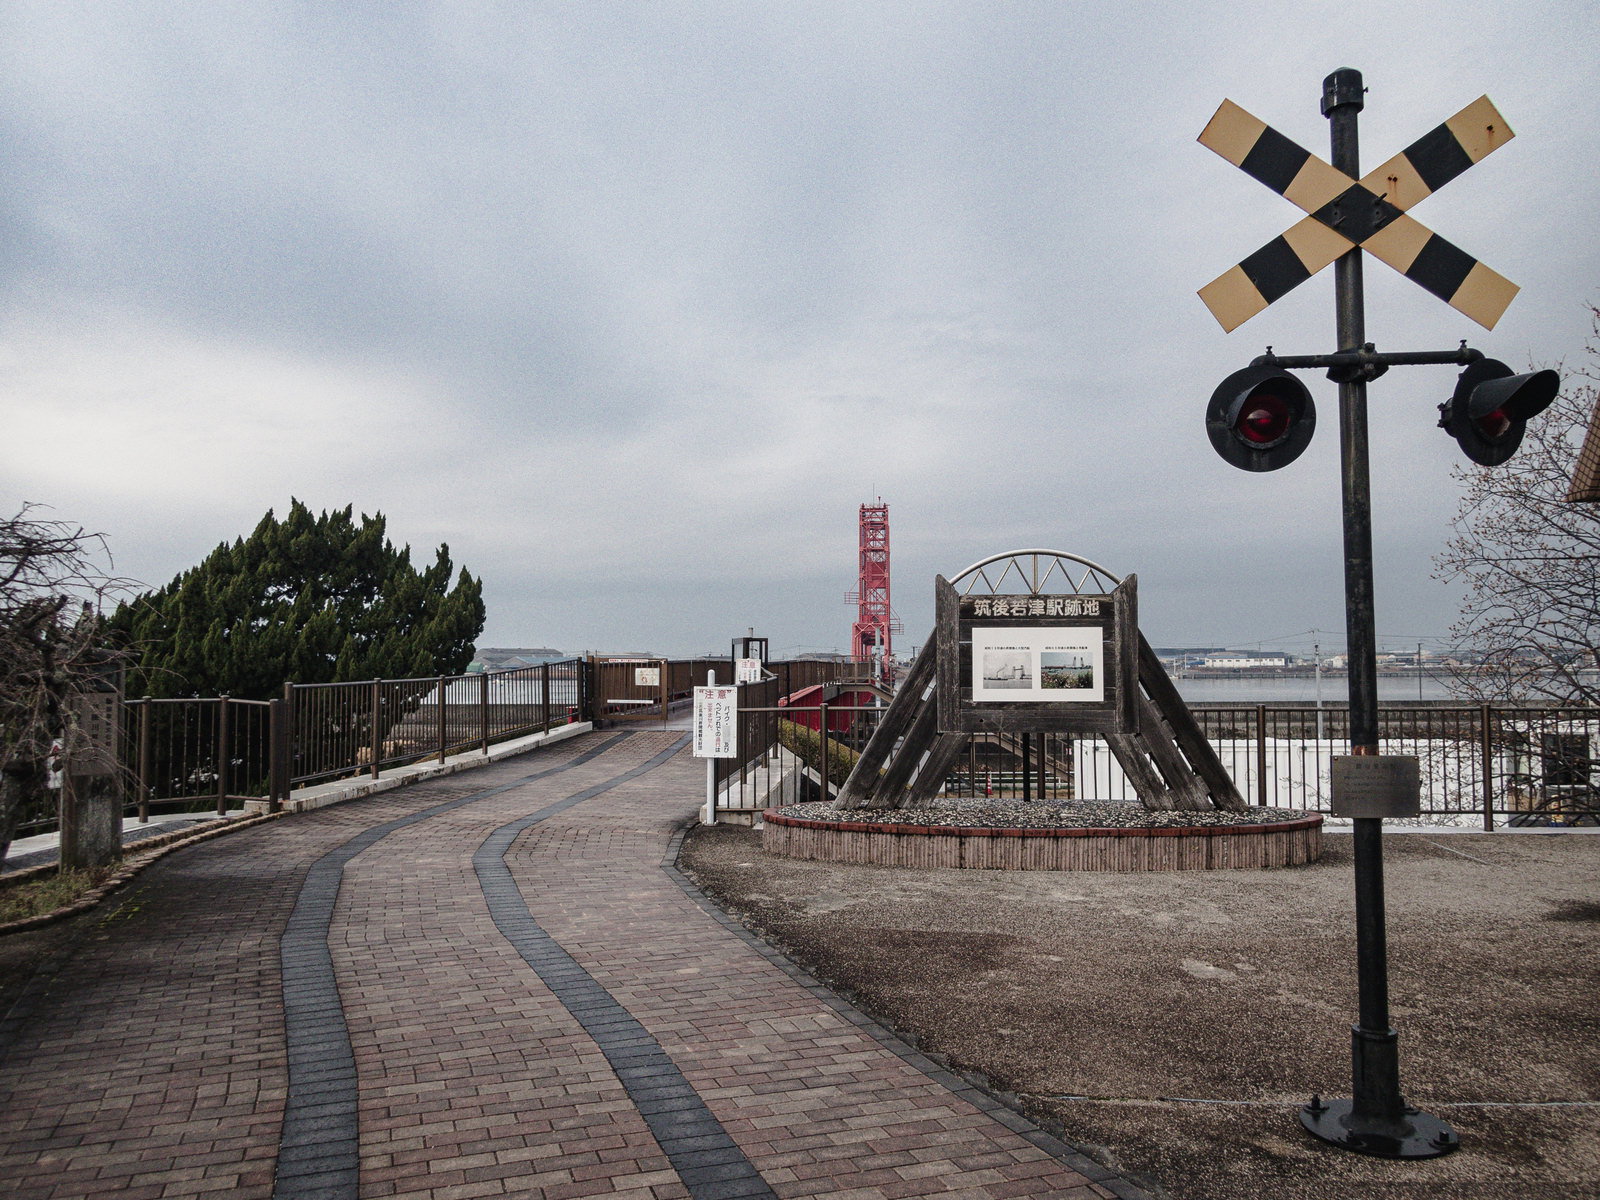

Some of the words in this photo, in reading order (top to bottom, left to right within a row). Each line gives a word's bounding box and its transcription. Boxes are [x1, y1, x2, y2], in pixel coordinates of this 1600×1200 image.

[974, 599, 1100, 617] 筑後若津駅跡地
